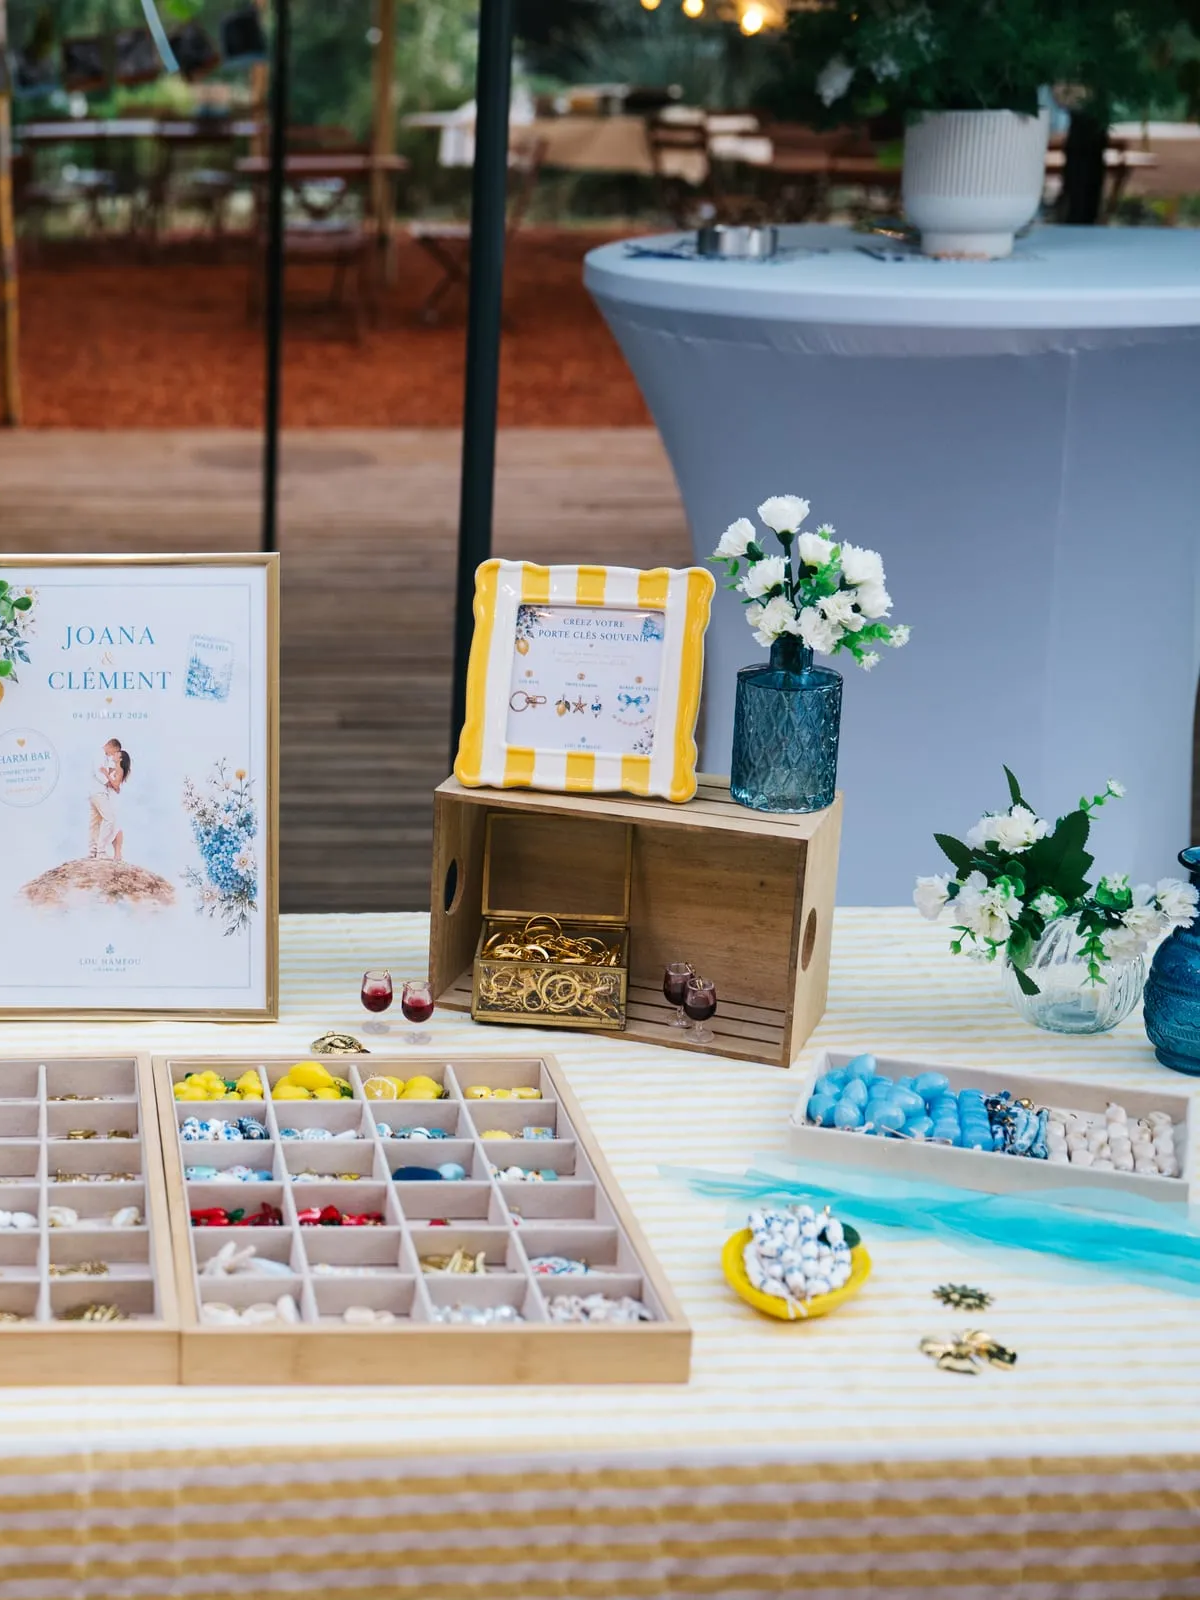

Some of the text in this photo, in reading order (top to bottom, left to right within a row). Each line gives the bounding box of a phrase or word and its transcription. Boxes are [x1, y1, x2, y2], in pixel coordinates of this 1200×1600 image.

[595, 619, 625, 628] VOTRE
[61, 625, 155, 651] JOANA
[538, 629, 649, 643] PORTE CLÉS SOUVENIR
[101, 651, 115, 666] &
[48, 667, 172, 690] CLÉMENT
[30, 751, 51, 761] BAR
